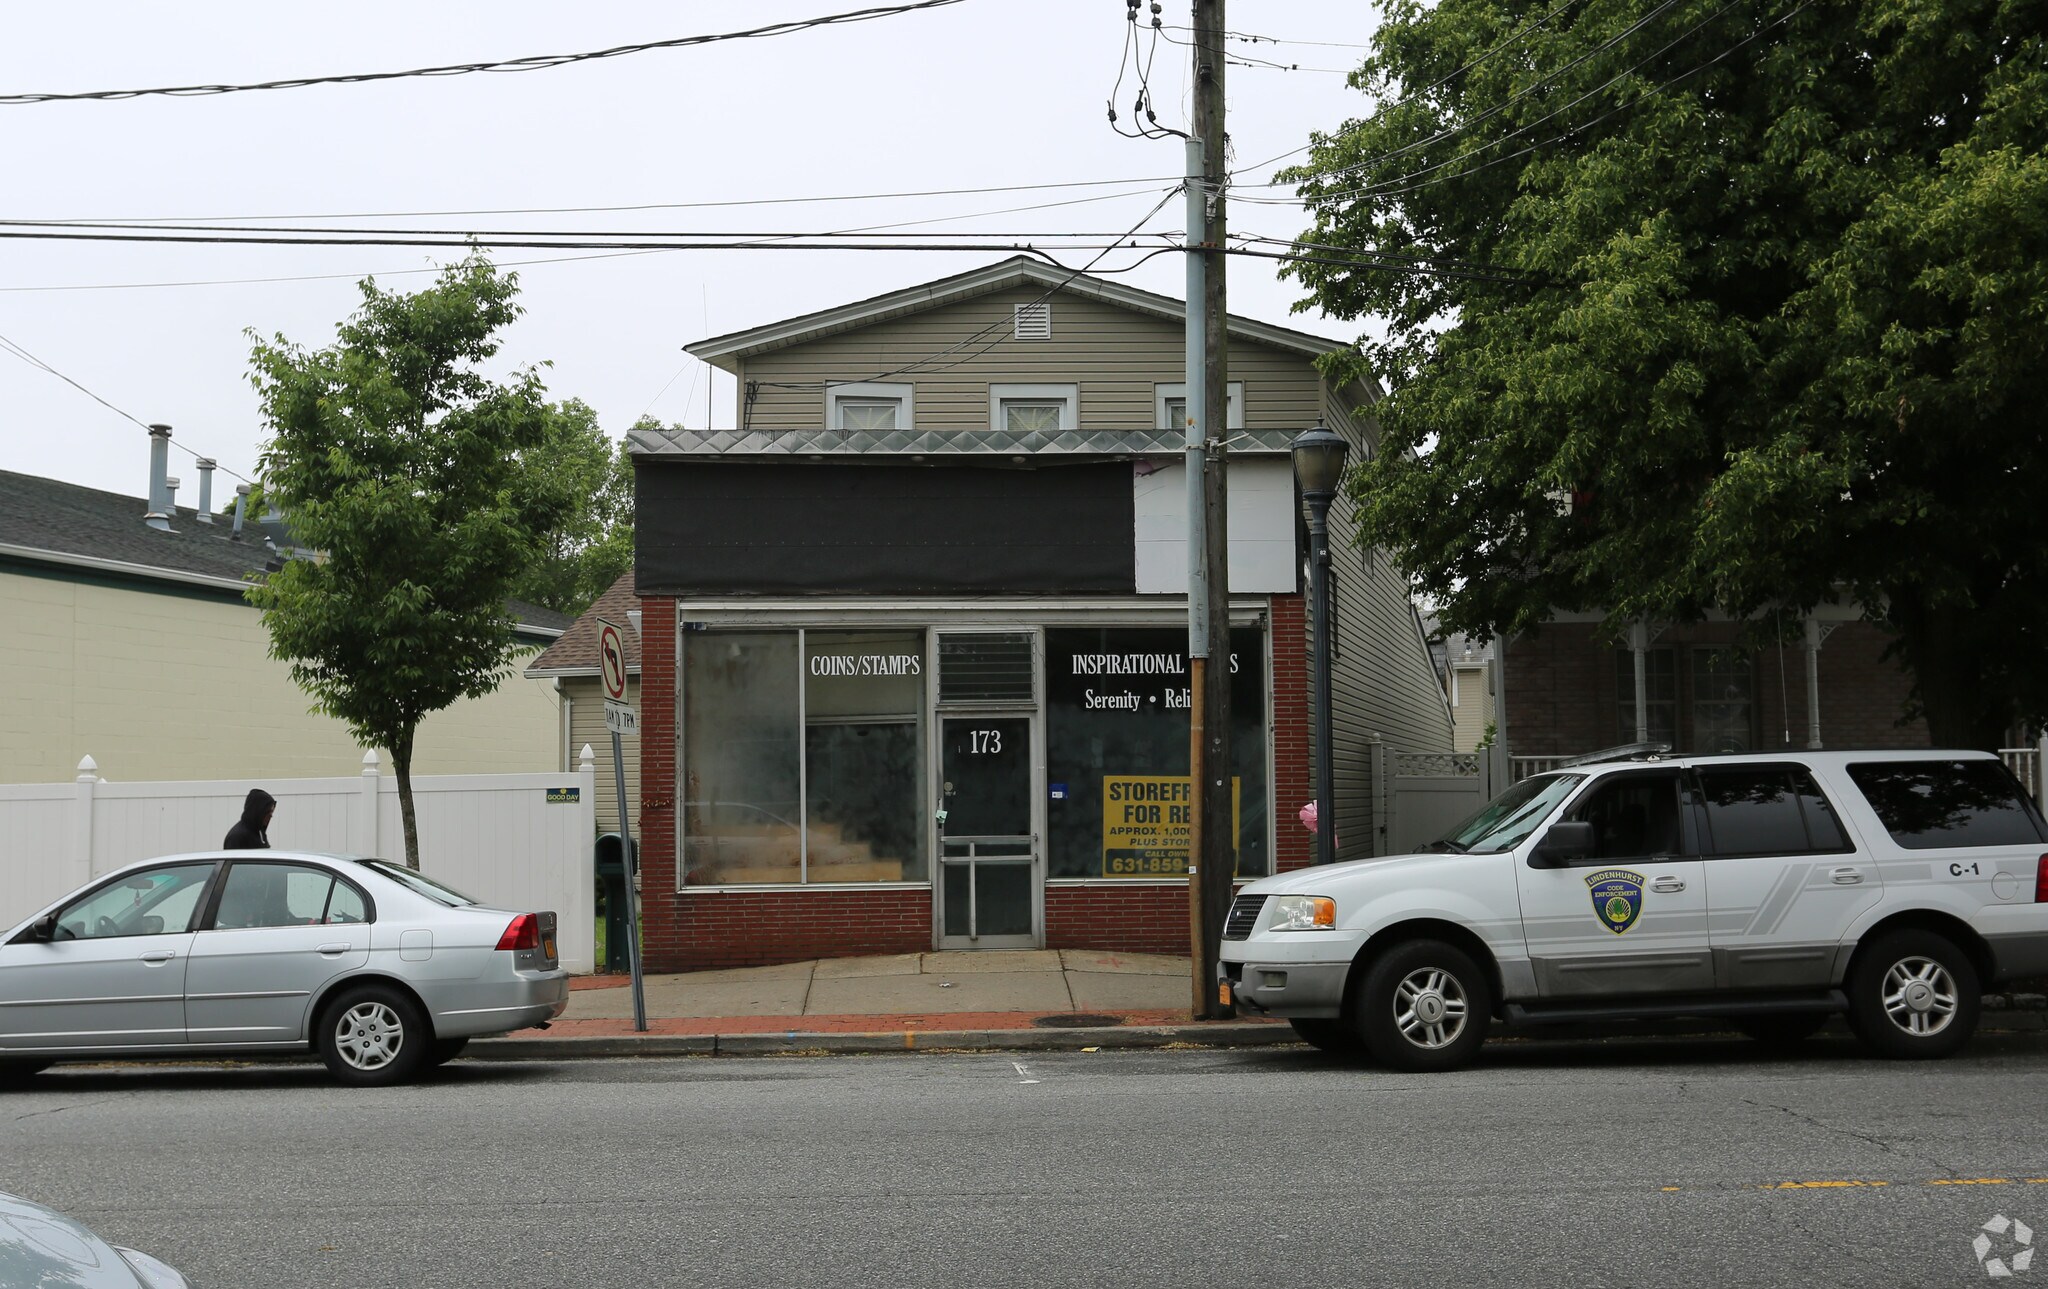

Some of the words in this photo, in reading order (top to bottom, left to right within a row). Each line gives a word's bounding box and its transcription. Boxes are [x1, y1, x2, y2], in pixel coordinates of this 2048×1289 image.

[811, 655, 921, 676] COINS/STAMPS
[1072, 653, 1184, 674] INSPIRATIONAL
[1085, 688, 1141, 711] Serenity
[970, 730, 1002, 754] 173
[1124, 805, 1160, 823] FOR
[1109, 827, 1160, 835] APPROX.
[1130, 838, 1158, 846] PLUS
[1145, 850, 1166, 858] CALL
[1949, 862, 1980, 877] C-1
[1587, 871, 1643, 885] LINDENHURST
[1594, 890, 1638, 898] ENFORCEMENT
